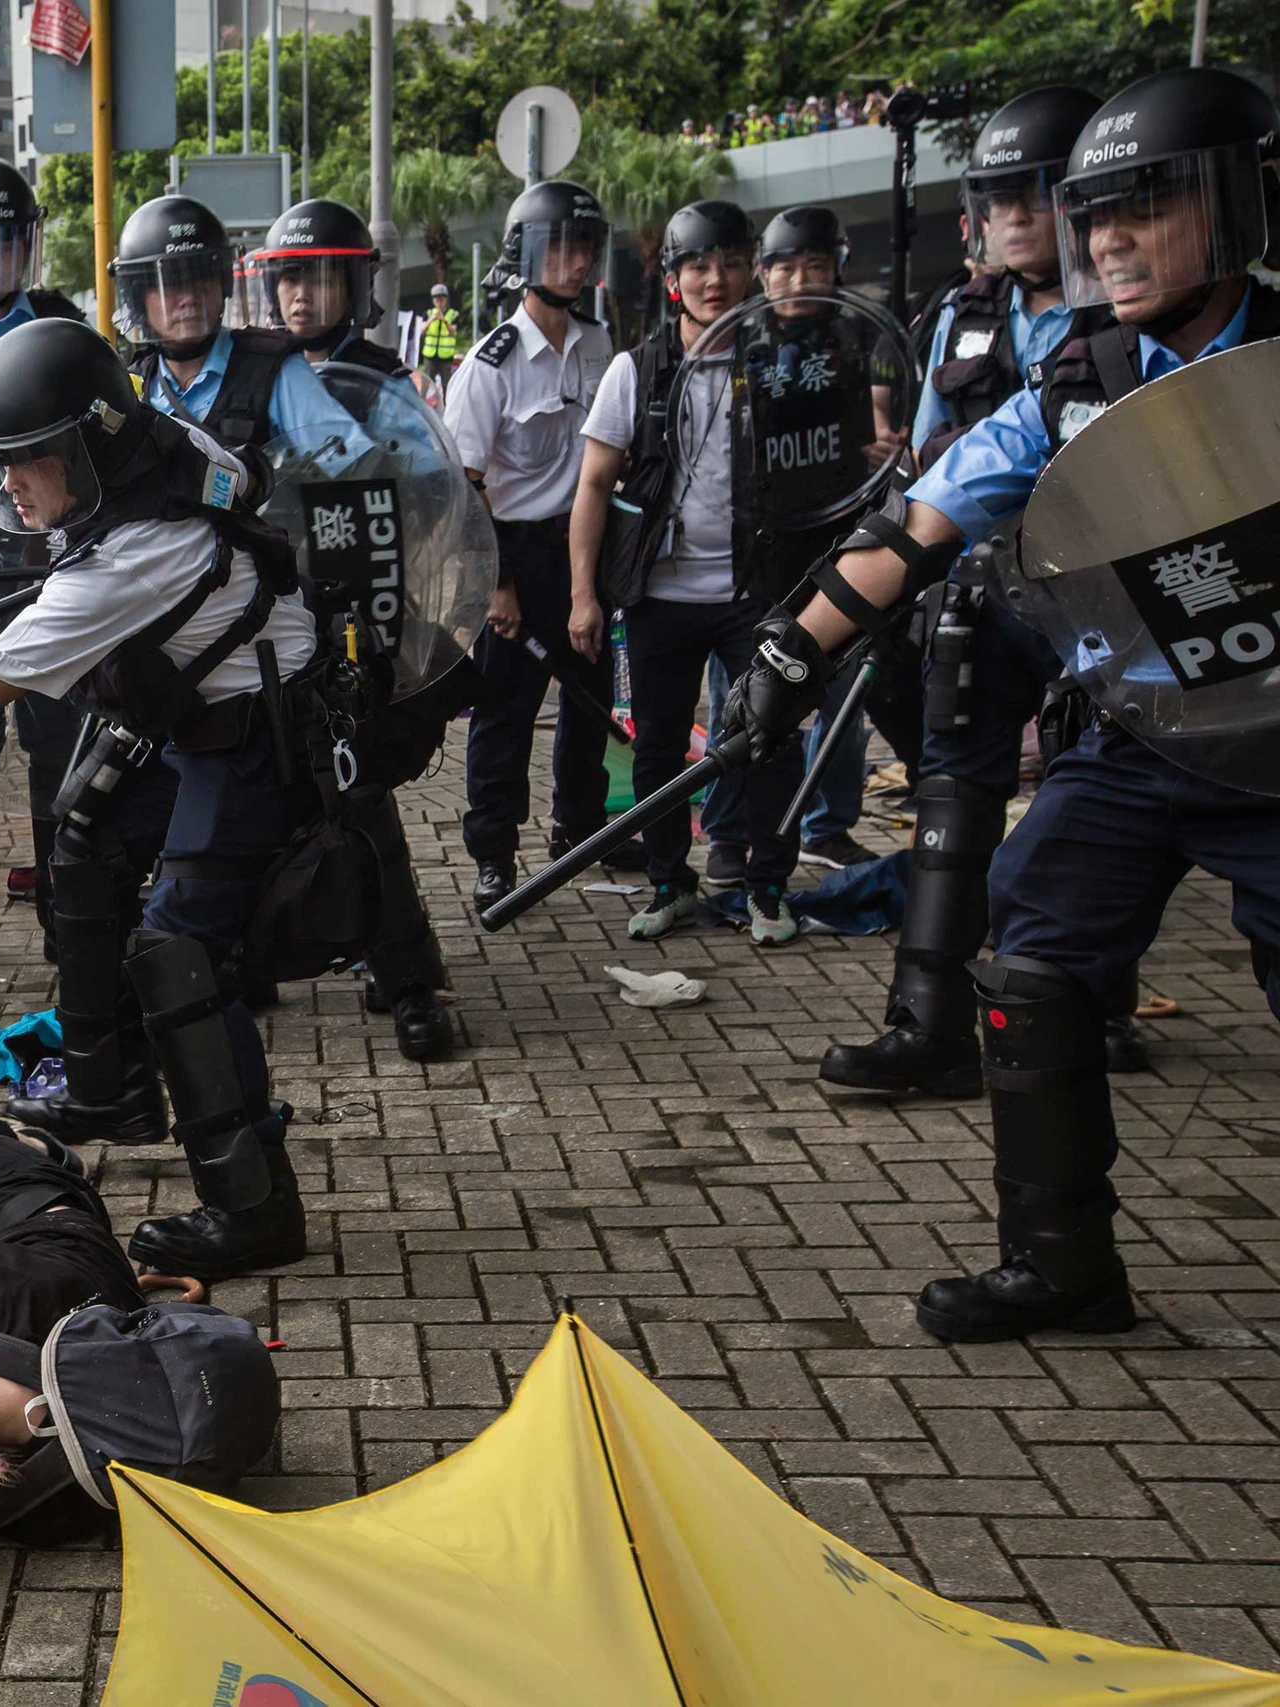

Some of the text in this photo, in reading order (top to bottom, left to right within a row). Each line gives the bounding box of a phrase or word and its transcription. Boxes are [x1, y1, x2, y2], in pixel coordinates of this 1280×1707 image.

[1095, 111, 1138, 140] 警察
[982, 149, 1023, 168] Police
[1083, 141, 1139, 169] Police
[279, 232, 314, 246] Police
[762, 353, 838, 399] 警察
[766, 423, 842, 473] POLICE
[311, 504, 358, 551] 察
[1148, 541, 1241, 618] 警
[1170, 609, 1280, 680] PO
[199, 1369, 213, 1406] QUECHUA
